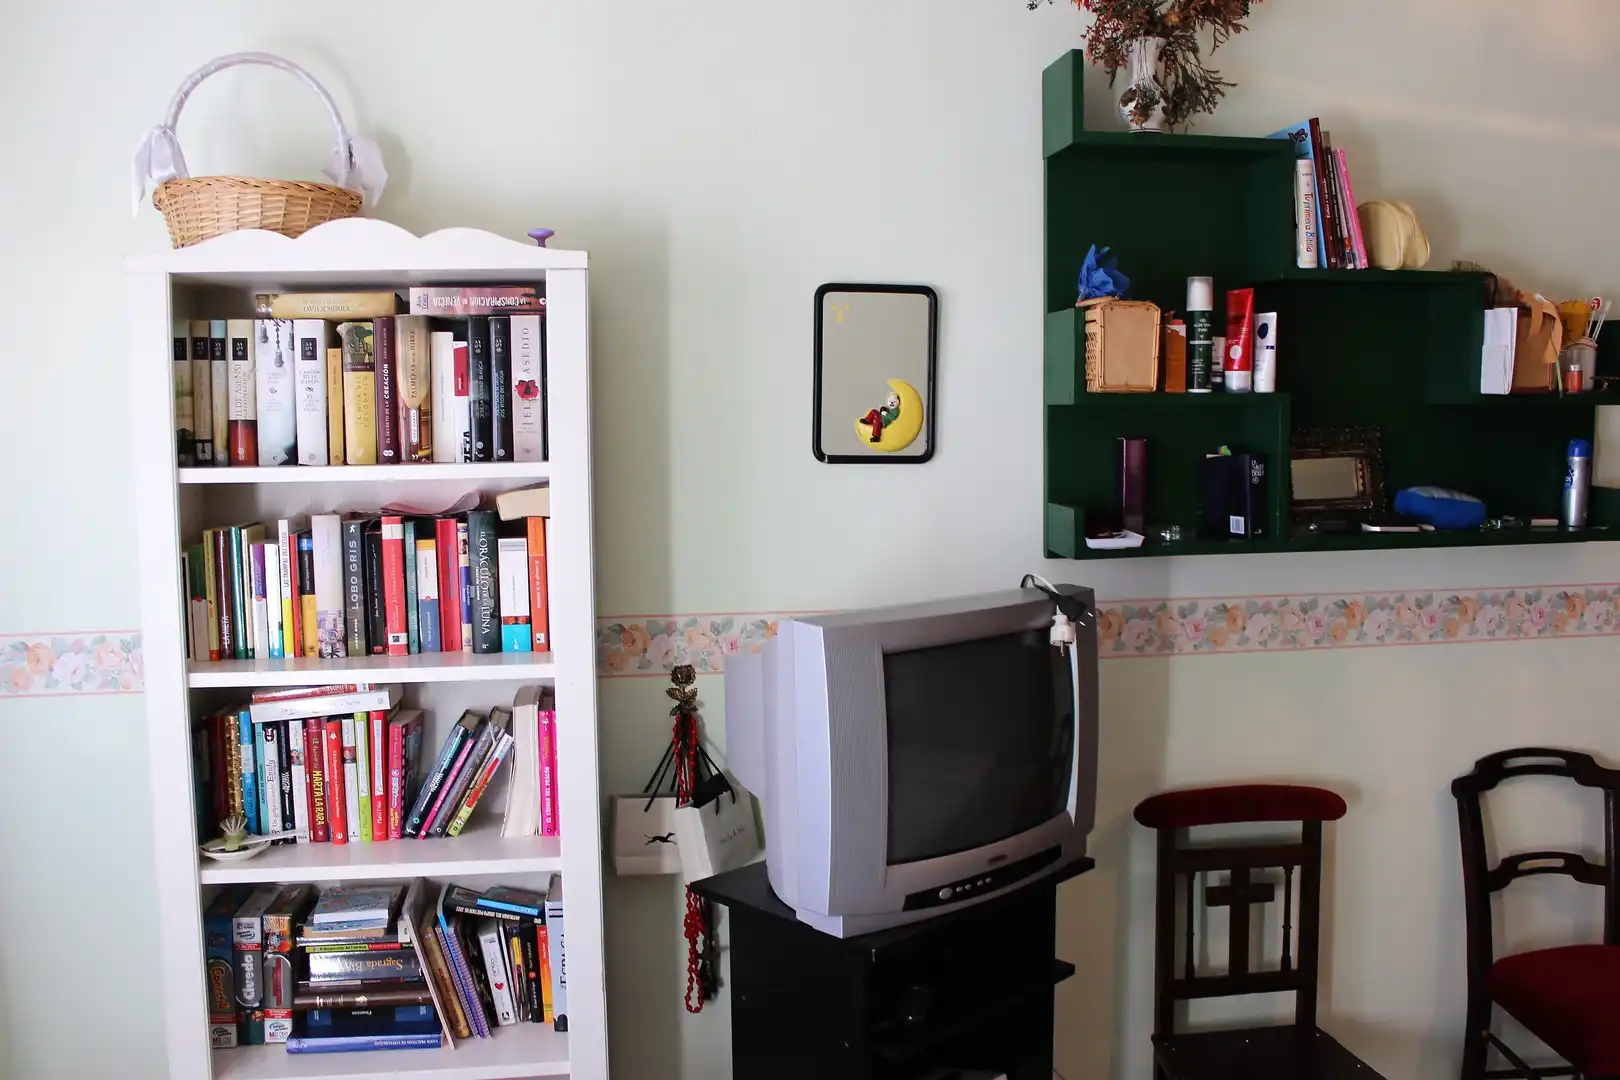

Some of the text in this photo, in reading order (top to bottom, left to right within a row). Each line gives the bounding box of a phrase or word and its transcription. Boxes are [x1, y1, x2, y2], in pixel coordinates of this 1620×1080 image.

[1303, 201, 1312, 230] primera
[1305, 231, 1315, 253] Biblia
[433, 296, 461, 307] VENECIA
[522, 327, 531, 374] ASEDIO
[382, 363, 390, 399] CREACIÓN
[349, 539, 359, 610] LOBO GRIS
[478, 538, 489, 590] ORÁCULO
[481, 606, 490, 635] LUNA
[266, 759, 275, 782] Emily
[312, 770, 323, 797] MARTA
[315, 798, 324, 807] LA
[315, 807, 325, 826] RARA
[241, 954, 255, 1000] Cluedo
[366, 956, 403, 971] Sagrada
